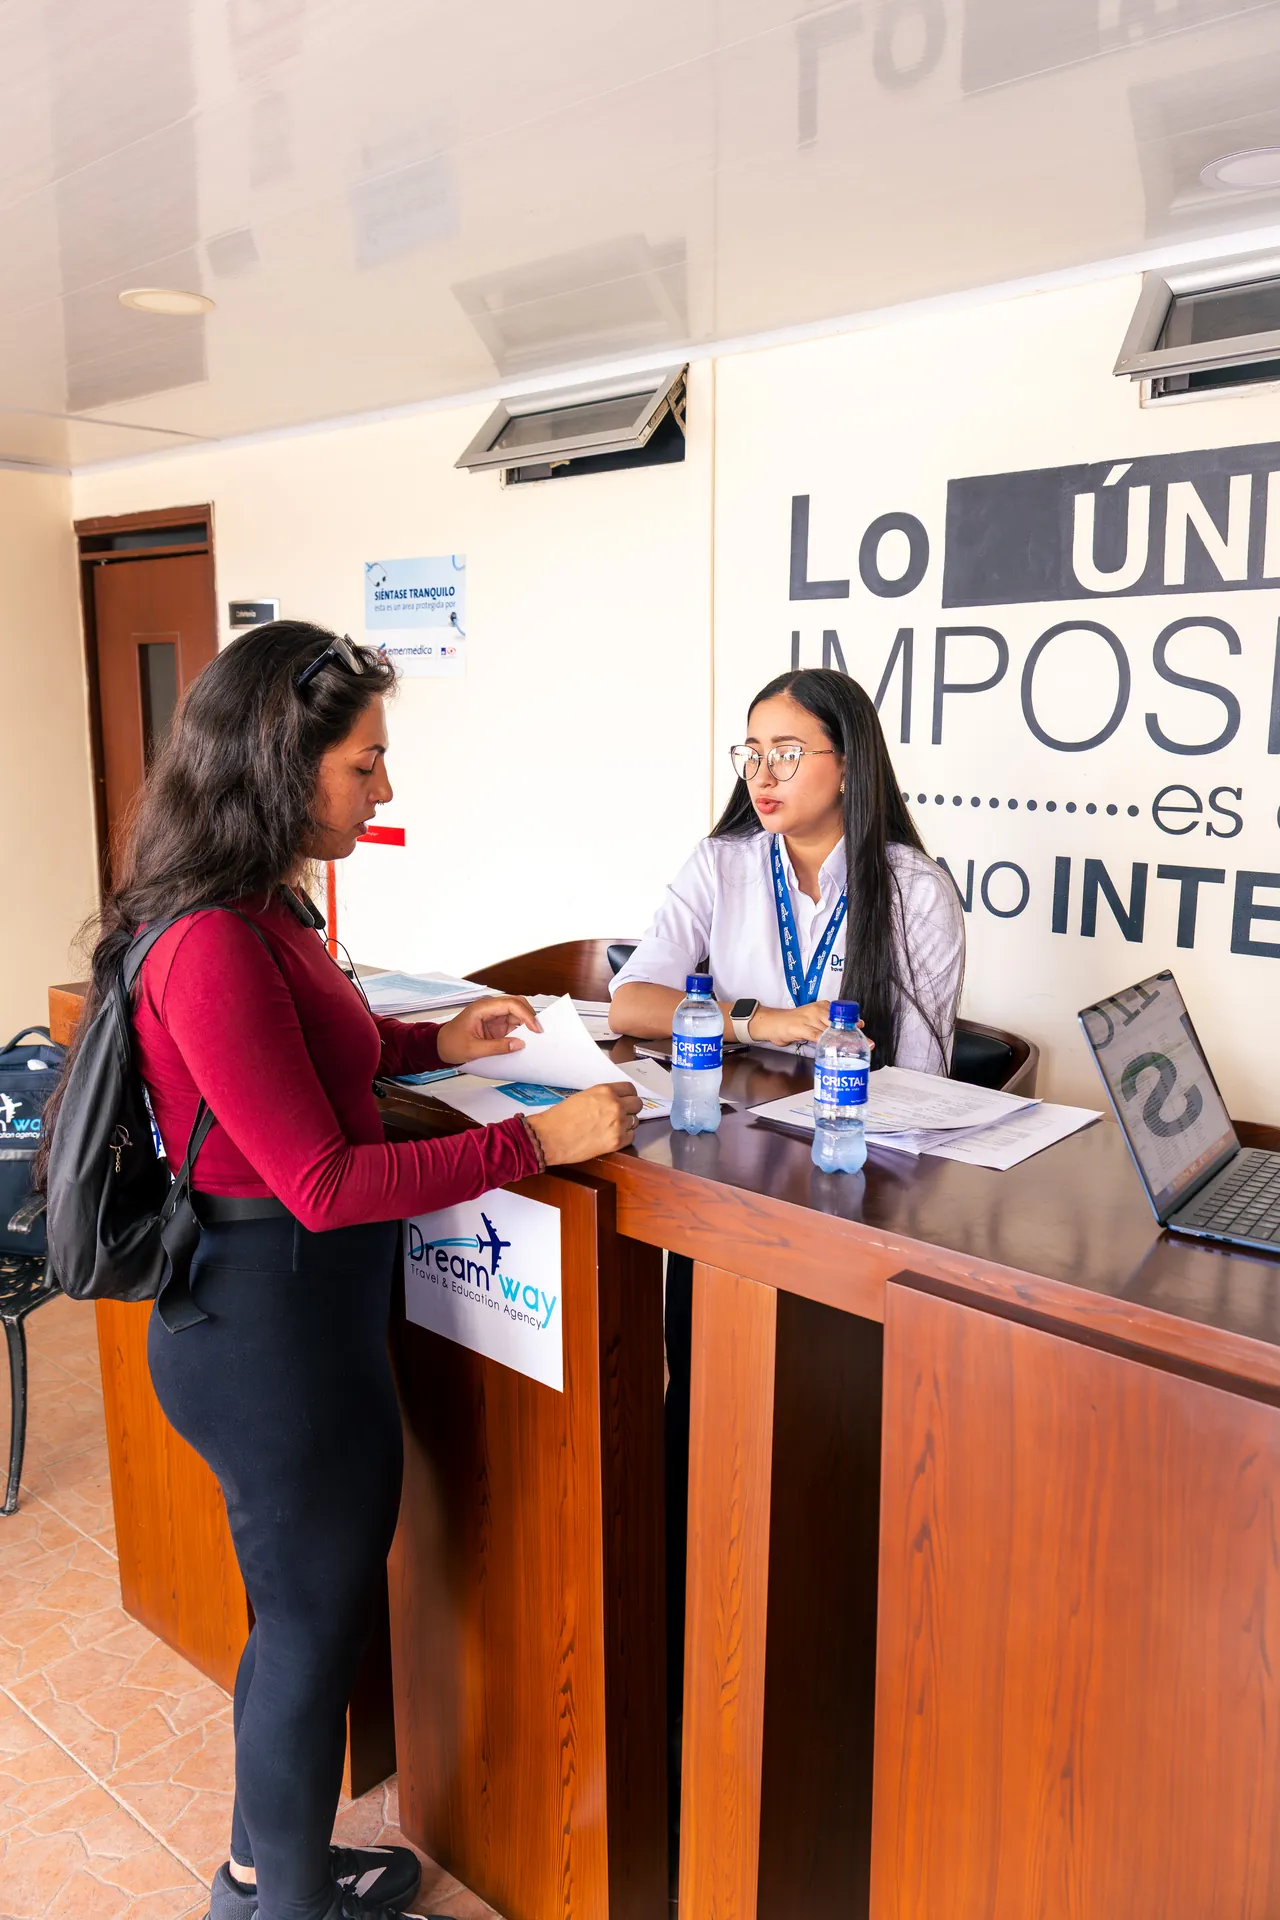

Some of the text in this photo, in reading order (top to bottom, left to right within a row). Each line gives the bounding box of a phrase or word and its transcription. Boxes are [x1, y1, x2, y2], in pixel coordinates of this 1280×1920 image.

[789, 494, 929, 600] Lo
[374, 586, 455, 600] SIÉNTASE TRANQUILO
[416, 600, 444, 612] protegida
[445, 600, 456, 610] por
[1152, 784, 1244, 838] es
[1052, 855, 1280, 959] INTE
[678, 1041, 718, 1054] CRISTAL
[822, 1075, 865, 1088] CRISTAL
[409, 1223, 557, 1329] Dream way
[410, 1263, 542, 1330] Travel & Education Agency
